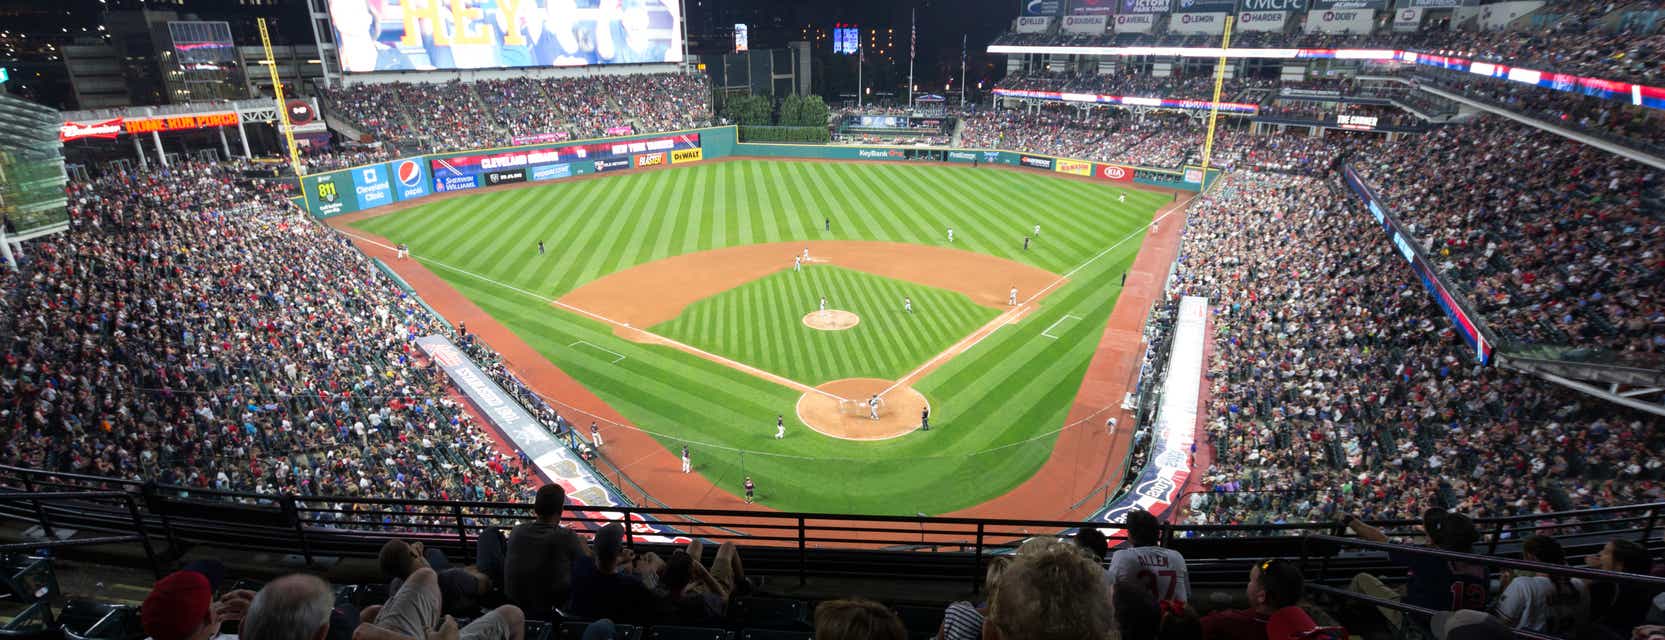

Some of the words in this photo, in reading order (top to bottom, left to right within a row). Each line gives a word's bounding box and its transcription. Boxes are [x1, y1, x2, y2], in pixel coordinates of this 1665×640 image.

[1191, 15, 1215, 24] LEMON
[1252, 14, 1282, 22] HARDER
[126, 117, 167, 134] HOME
[168, 116, 196, 131] RUN
[197, 112, 239, 129] PORCH
[859, 150, 888, 158] KeyBank
[1108, 168, 1121, 177] KIA
[318, 182, 336, 198] 811
[356, 181, 389, 194] Cleveland
[404, 187, 423, 197] pepsi
[365, 192, 384, 201] Clinic
[1138, 555, 1168, 568] ALLEN
